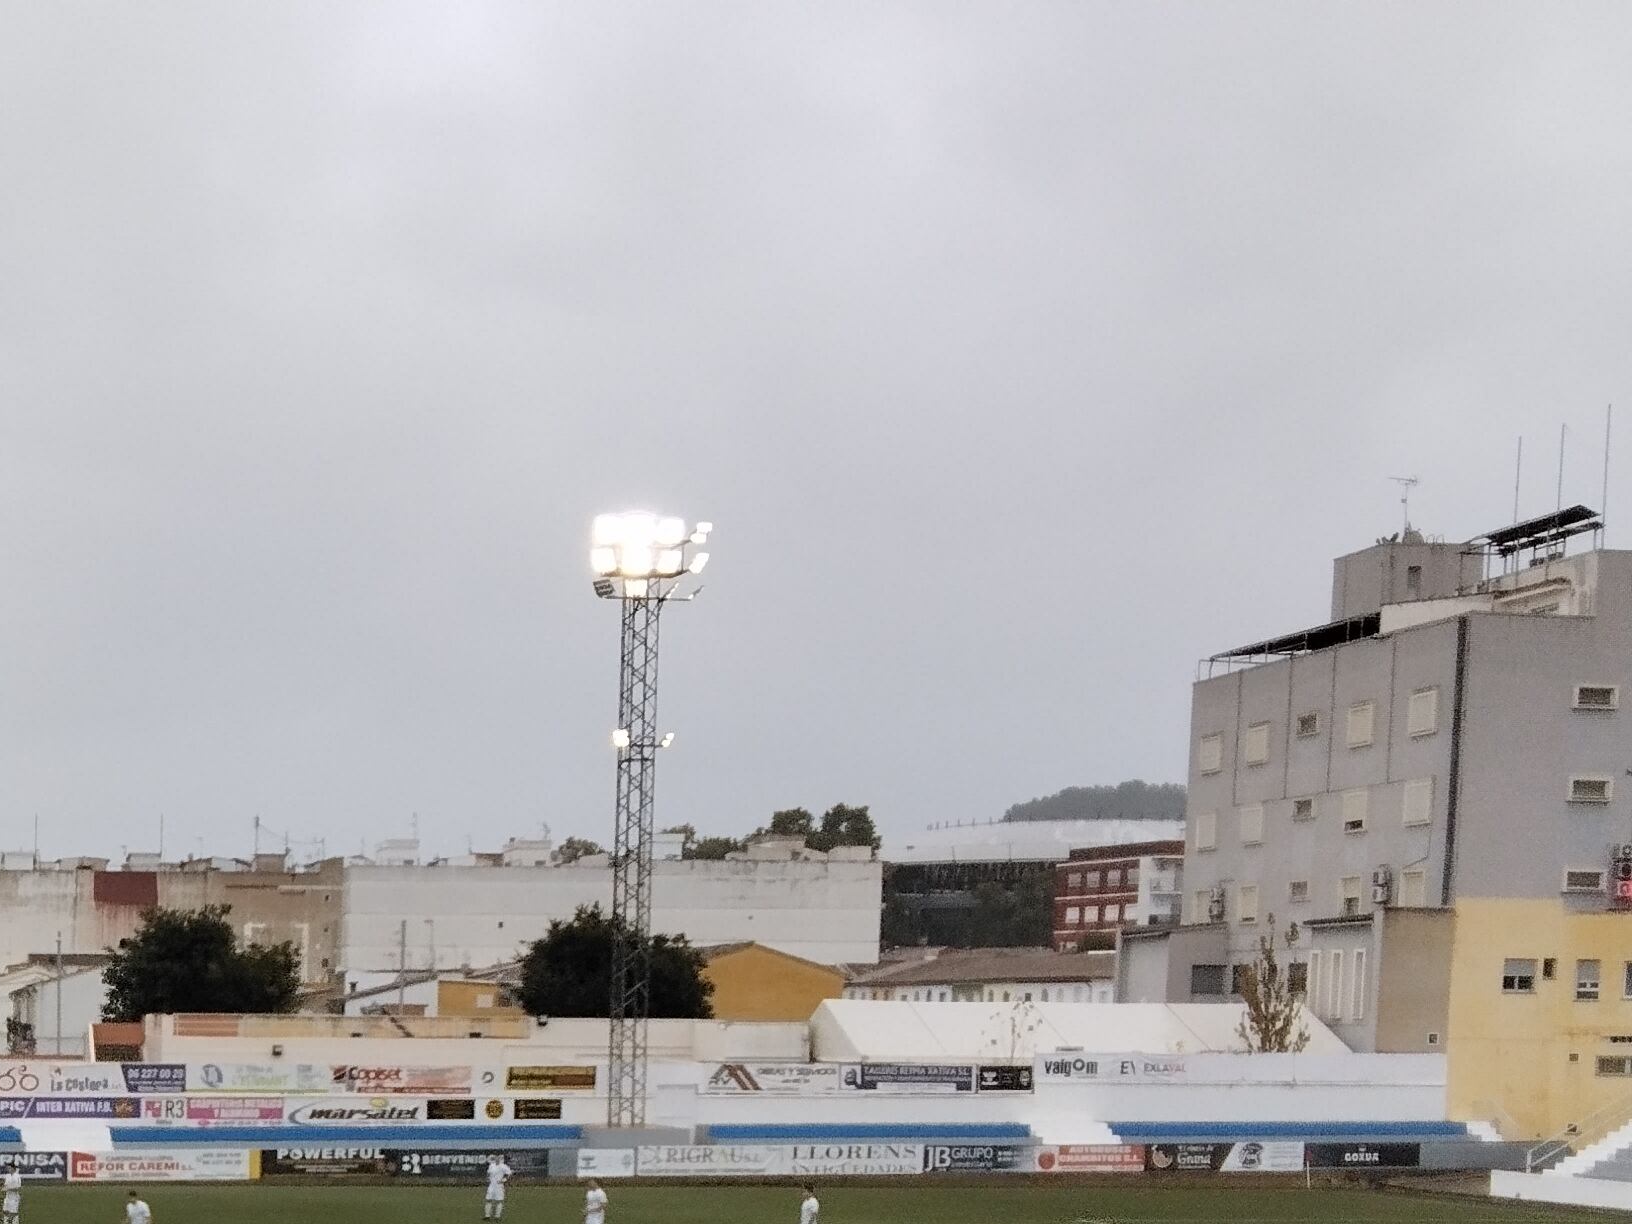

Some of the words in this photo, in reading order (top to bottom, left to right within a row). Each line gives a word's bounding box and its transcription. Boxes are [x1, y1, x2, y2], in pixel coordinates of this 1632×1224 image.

[166, 1100, 184, 1118] R3
[277, 1148, 386, 1160] POWERFUL
[792, 1145, 917, 1160] LLORENS
[924, 1146, 951, 1172] JB
[951, 1147, 994, 1160] GRUPO
[129, 1162, 180, 1171] CAREMI
